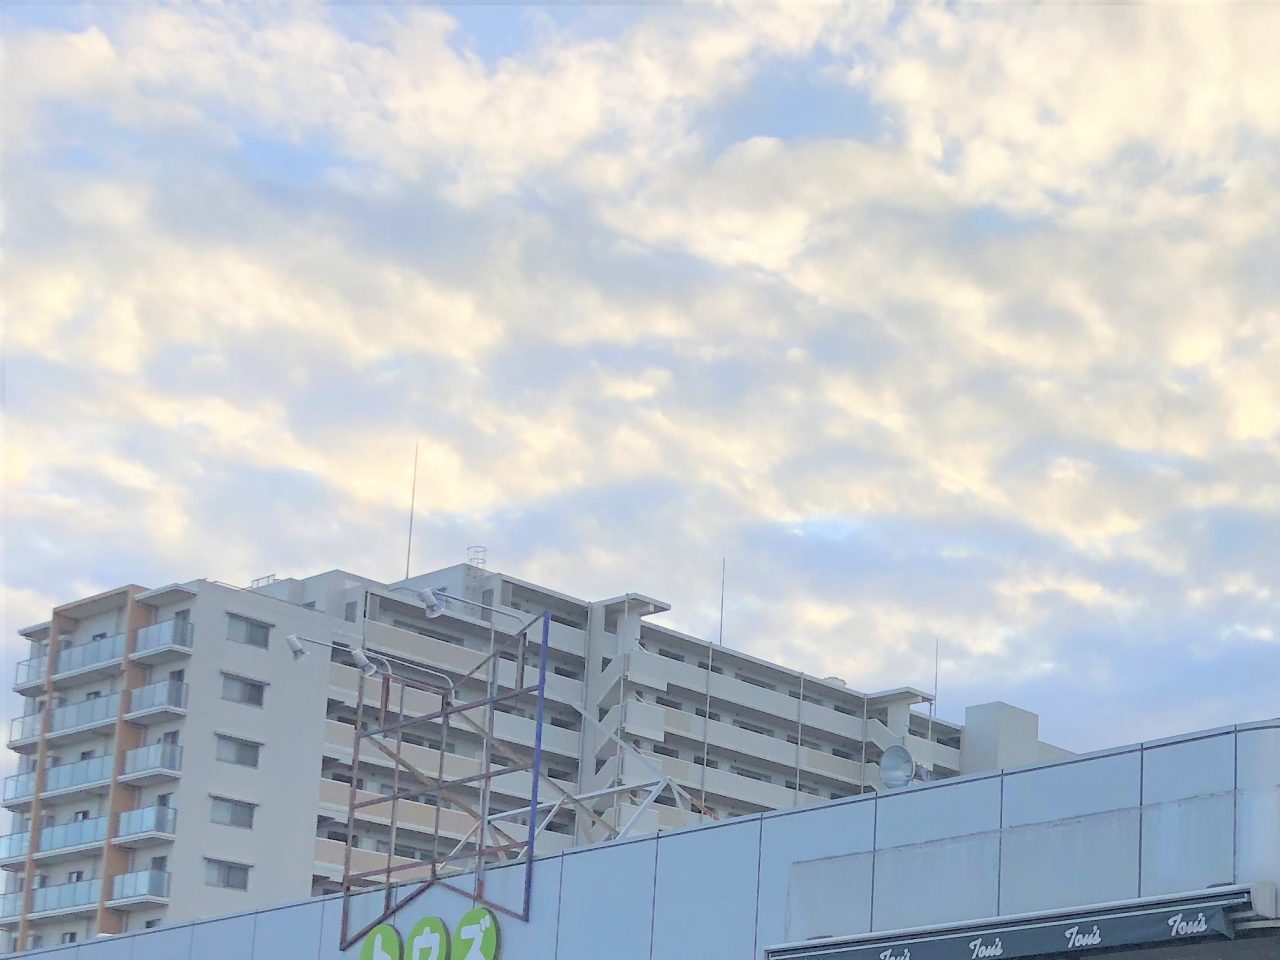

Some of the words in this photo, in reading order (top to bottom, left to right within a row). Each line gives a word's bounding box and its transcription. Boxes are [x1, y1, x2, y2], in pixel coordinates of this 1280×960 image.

[968, 937, 1004, 960] Tou's
[1064, 925, 1102, 949] Tou's
[1167, 912, 1208, 937] Tou's
